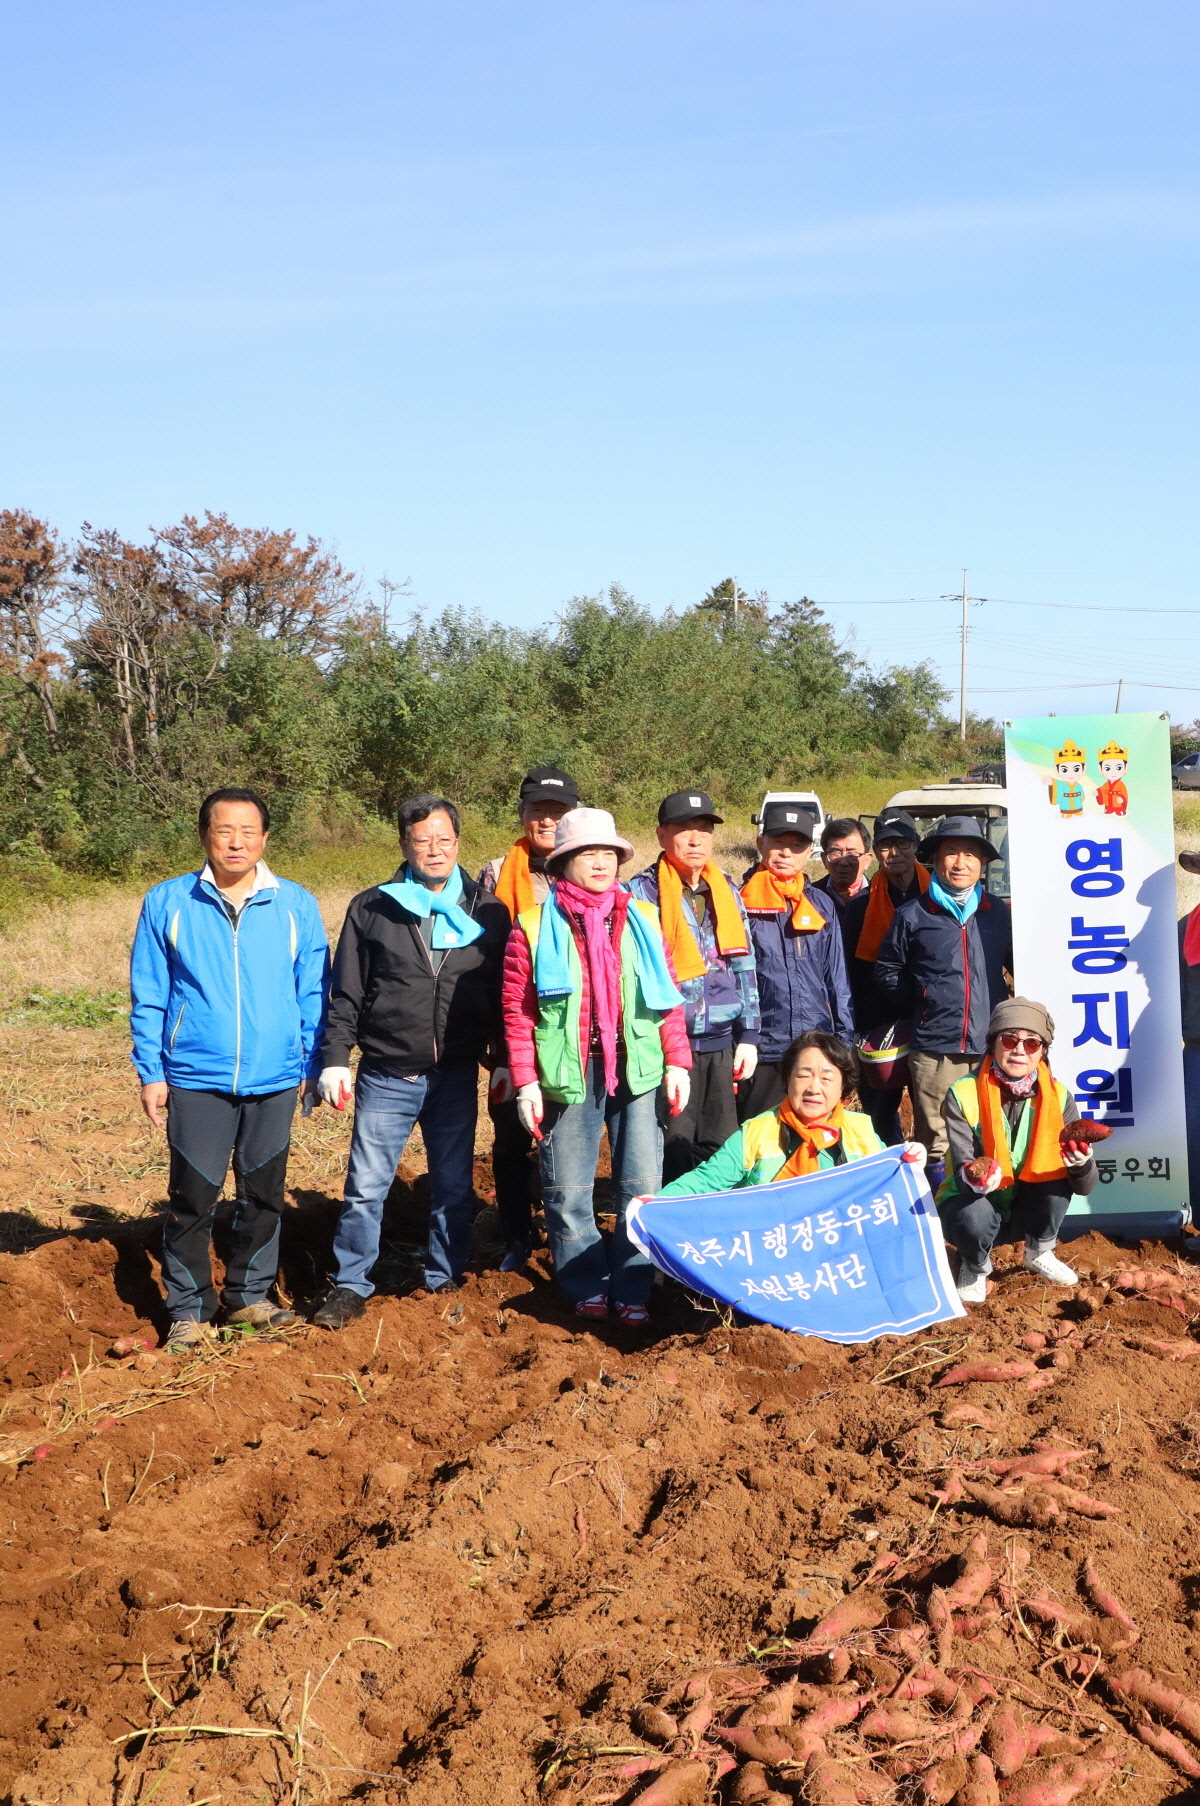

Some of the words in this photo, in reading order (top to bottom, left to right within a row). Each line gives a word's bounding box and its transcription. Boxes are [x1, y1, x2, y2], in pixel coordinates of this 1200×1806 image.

[1065, 838, 1134, 1127] 영농지원
[676, 1230, 753, 1267] 경주시
[761, 1192, 899, 1259] 행정동우회
[739, 1253, 867, 1302] 자원봉사단
